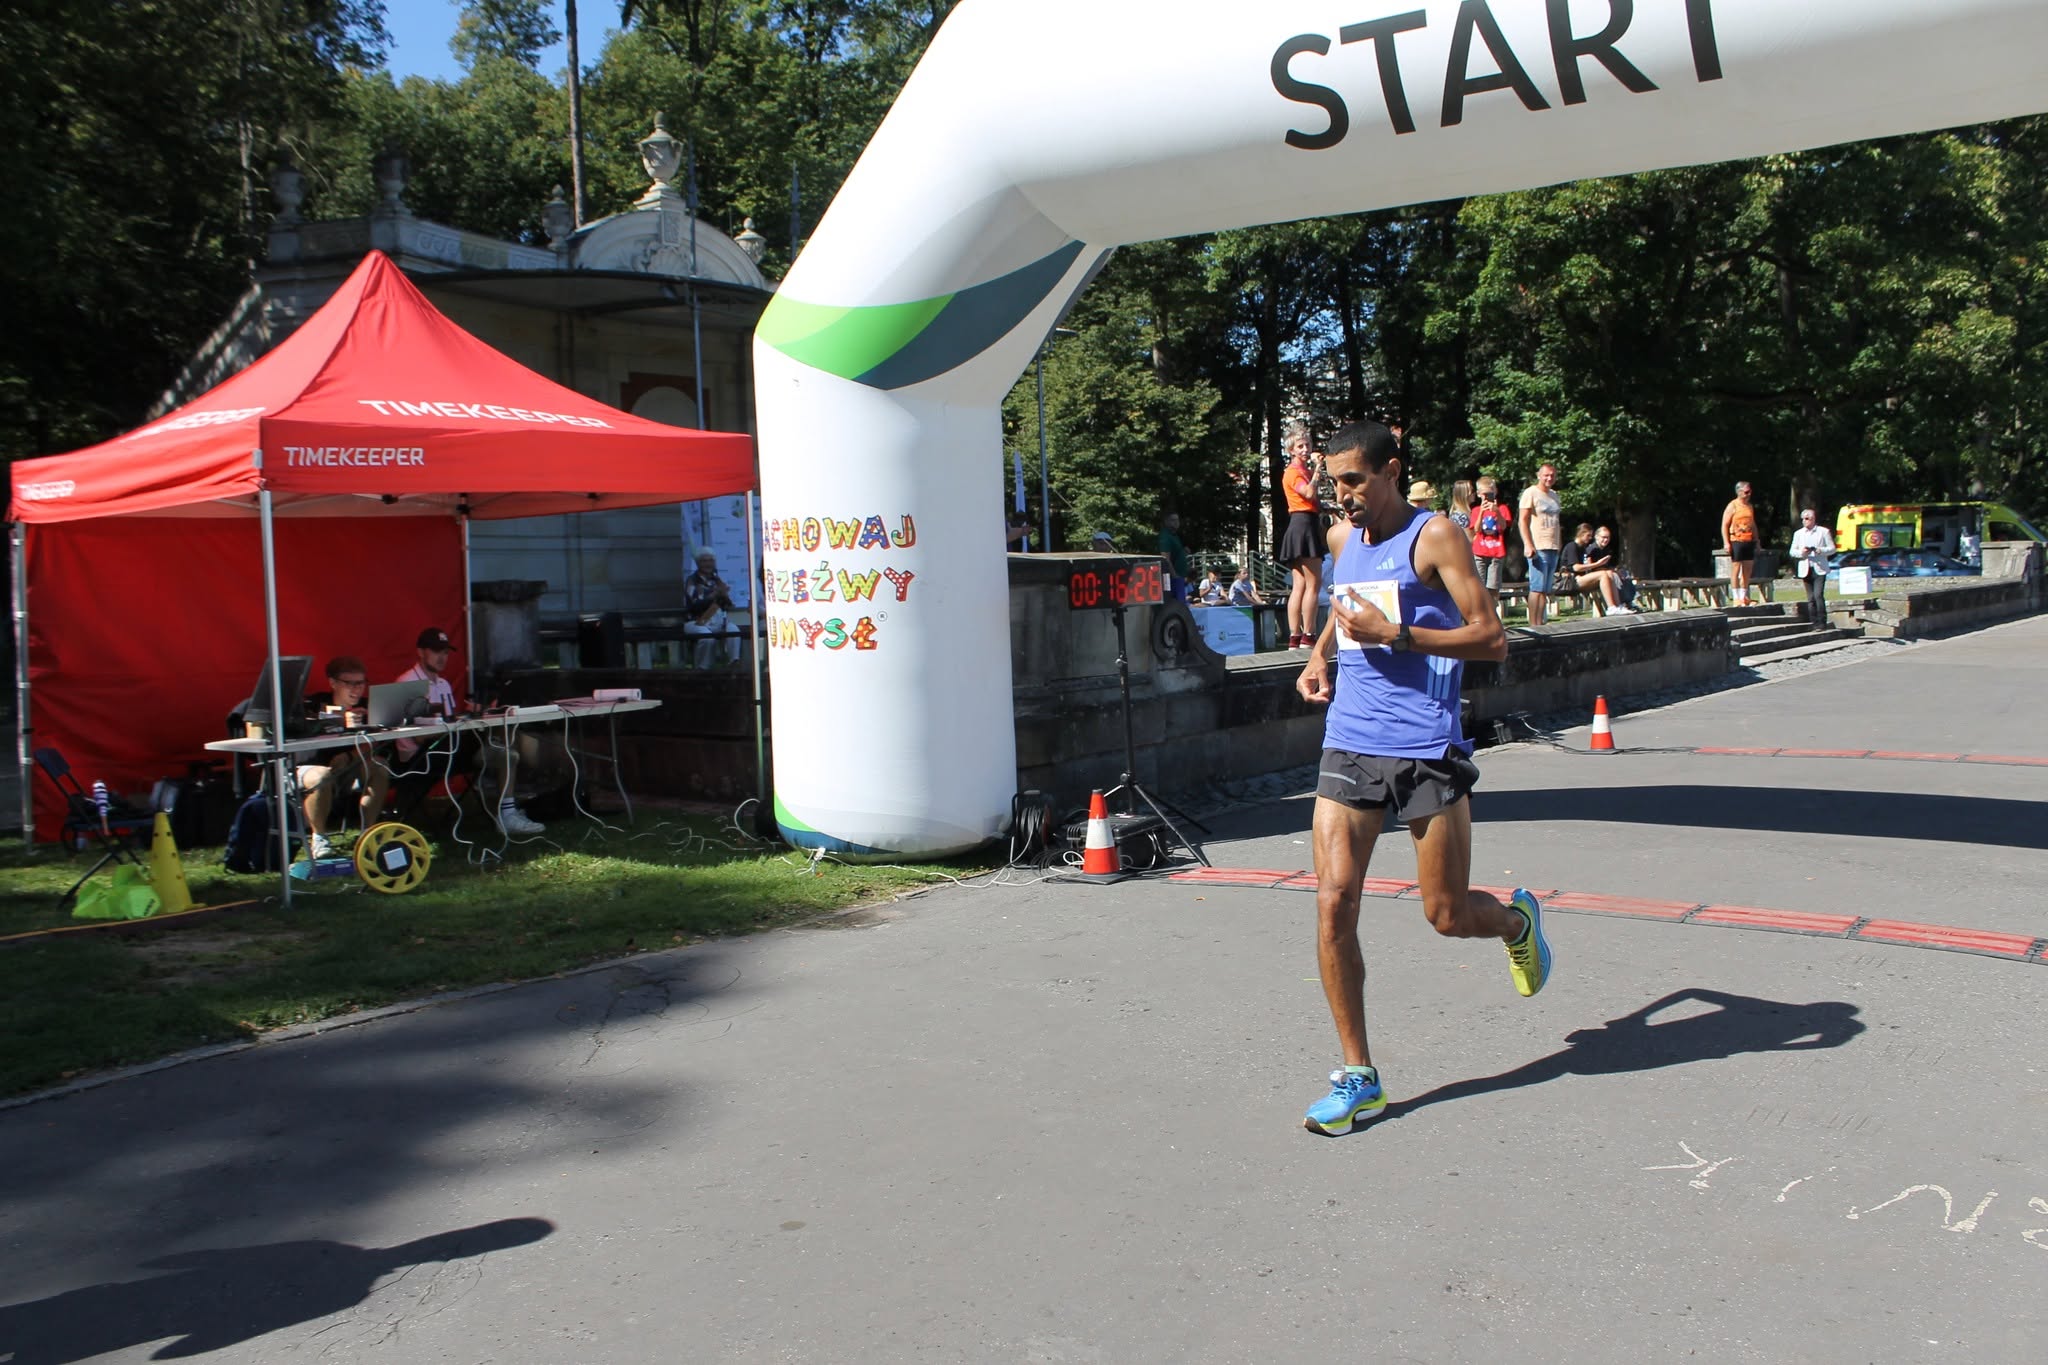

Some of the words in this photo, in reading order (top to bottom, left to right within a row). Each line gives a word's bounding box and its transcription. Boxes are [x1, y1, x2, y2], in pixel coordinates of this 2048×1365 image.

[358, 399, 615, 429] TIMEKEEPER
[283, 446, 425, 467] TIMEKEEPER
[1071, 565, 1162, 607] 00:16:26
